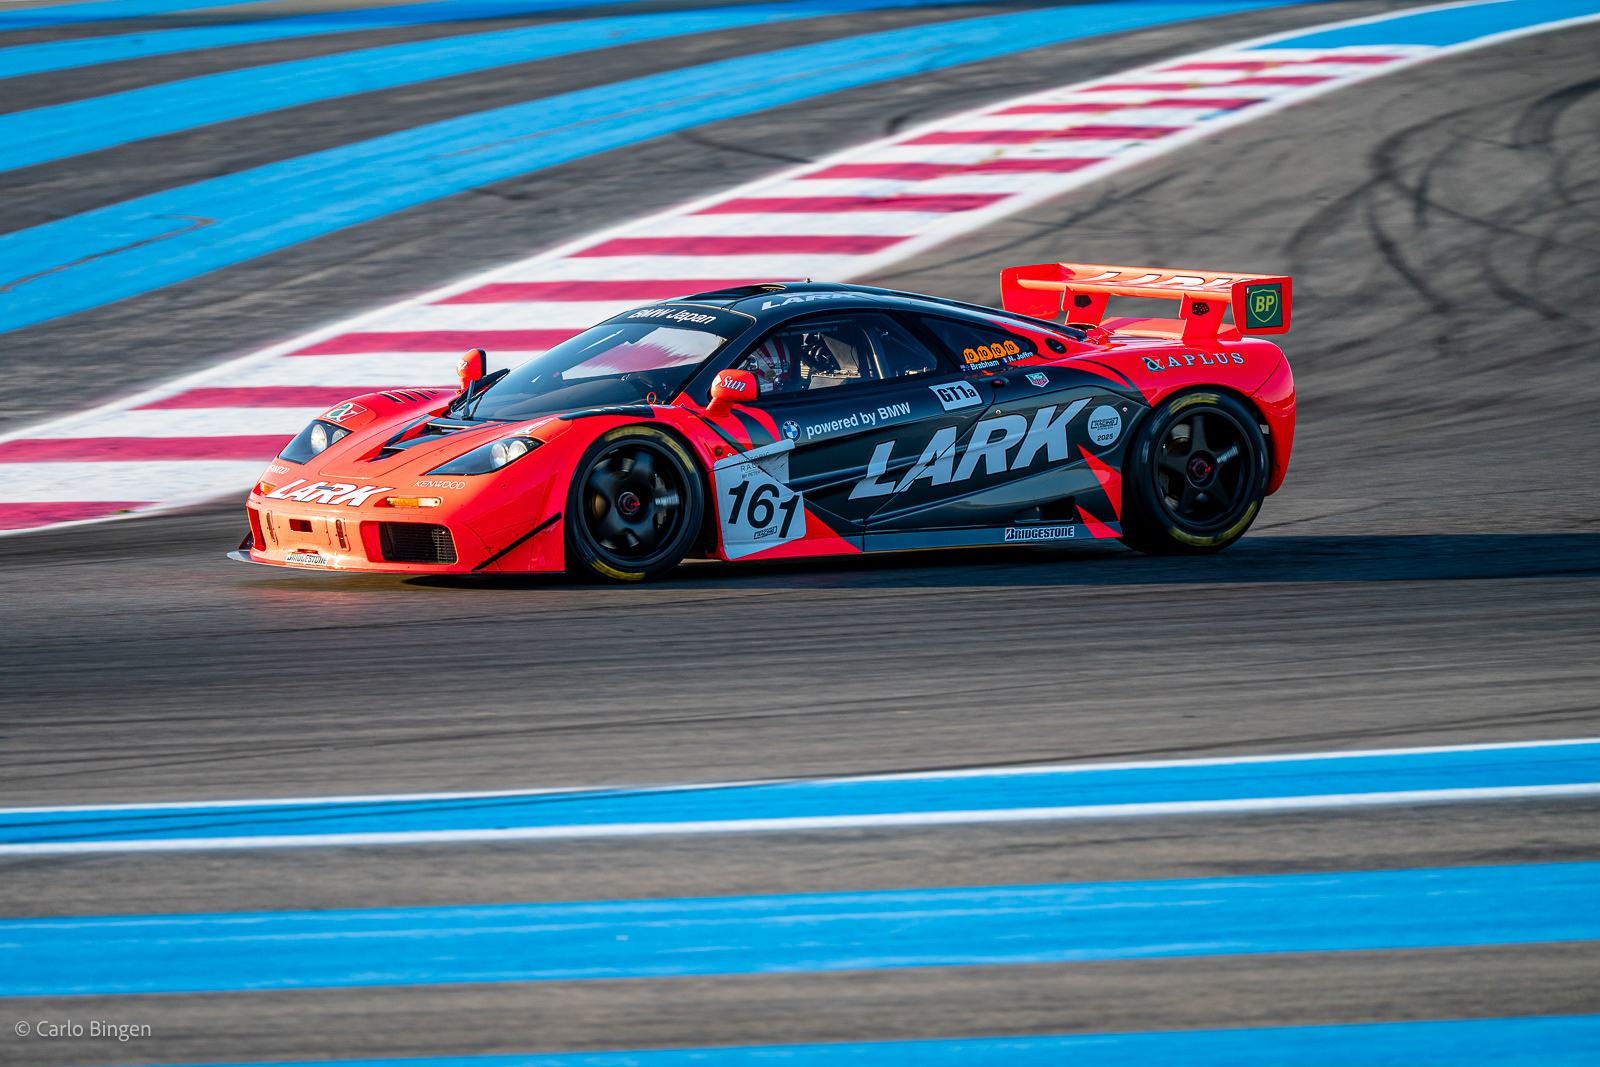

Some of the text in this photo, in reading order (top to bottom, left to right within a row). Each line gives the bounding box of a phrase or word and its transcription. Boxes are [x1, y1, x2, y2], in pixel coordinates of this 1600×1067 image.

[1255, 295, 1275, 312] BP
[627, 308, 717, 324] BMW Japan
[965, 344, 1015, 360] 10 10 10 10
[1167, 352, 1244, 367] APLUS
[970, 360, 1000, 371] Brabham
[720, 375, 746, 392] Sun
[936, 385, 977, 403] GT1a
[806, 402, 911, 440] powered by BMW
[1097, 433, 1114, 442] 2025
[847, 397, 1094, 501] LARK
[265, 478, 396, 507] LARK
[414, 480, 466, 490] KENWOOD
[728, 480, 800, 539] 161
[1005, 527, 1074, 540] BRIDGESTONE
